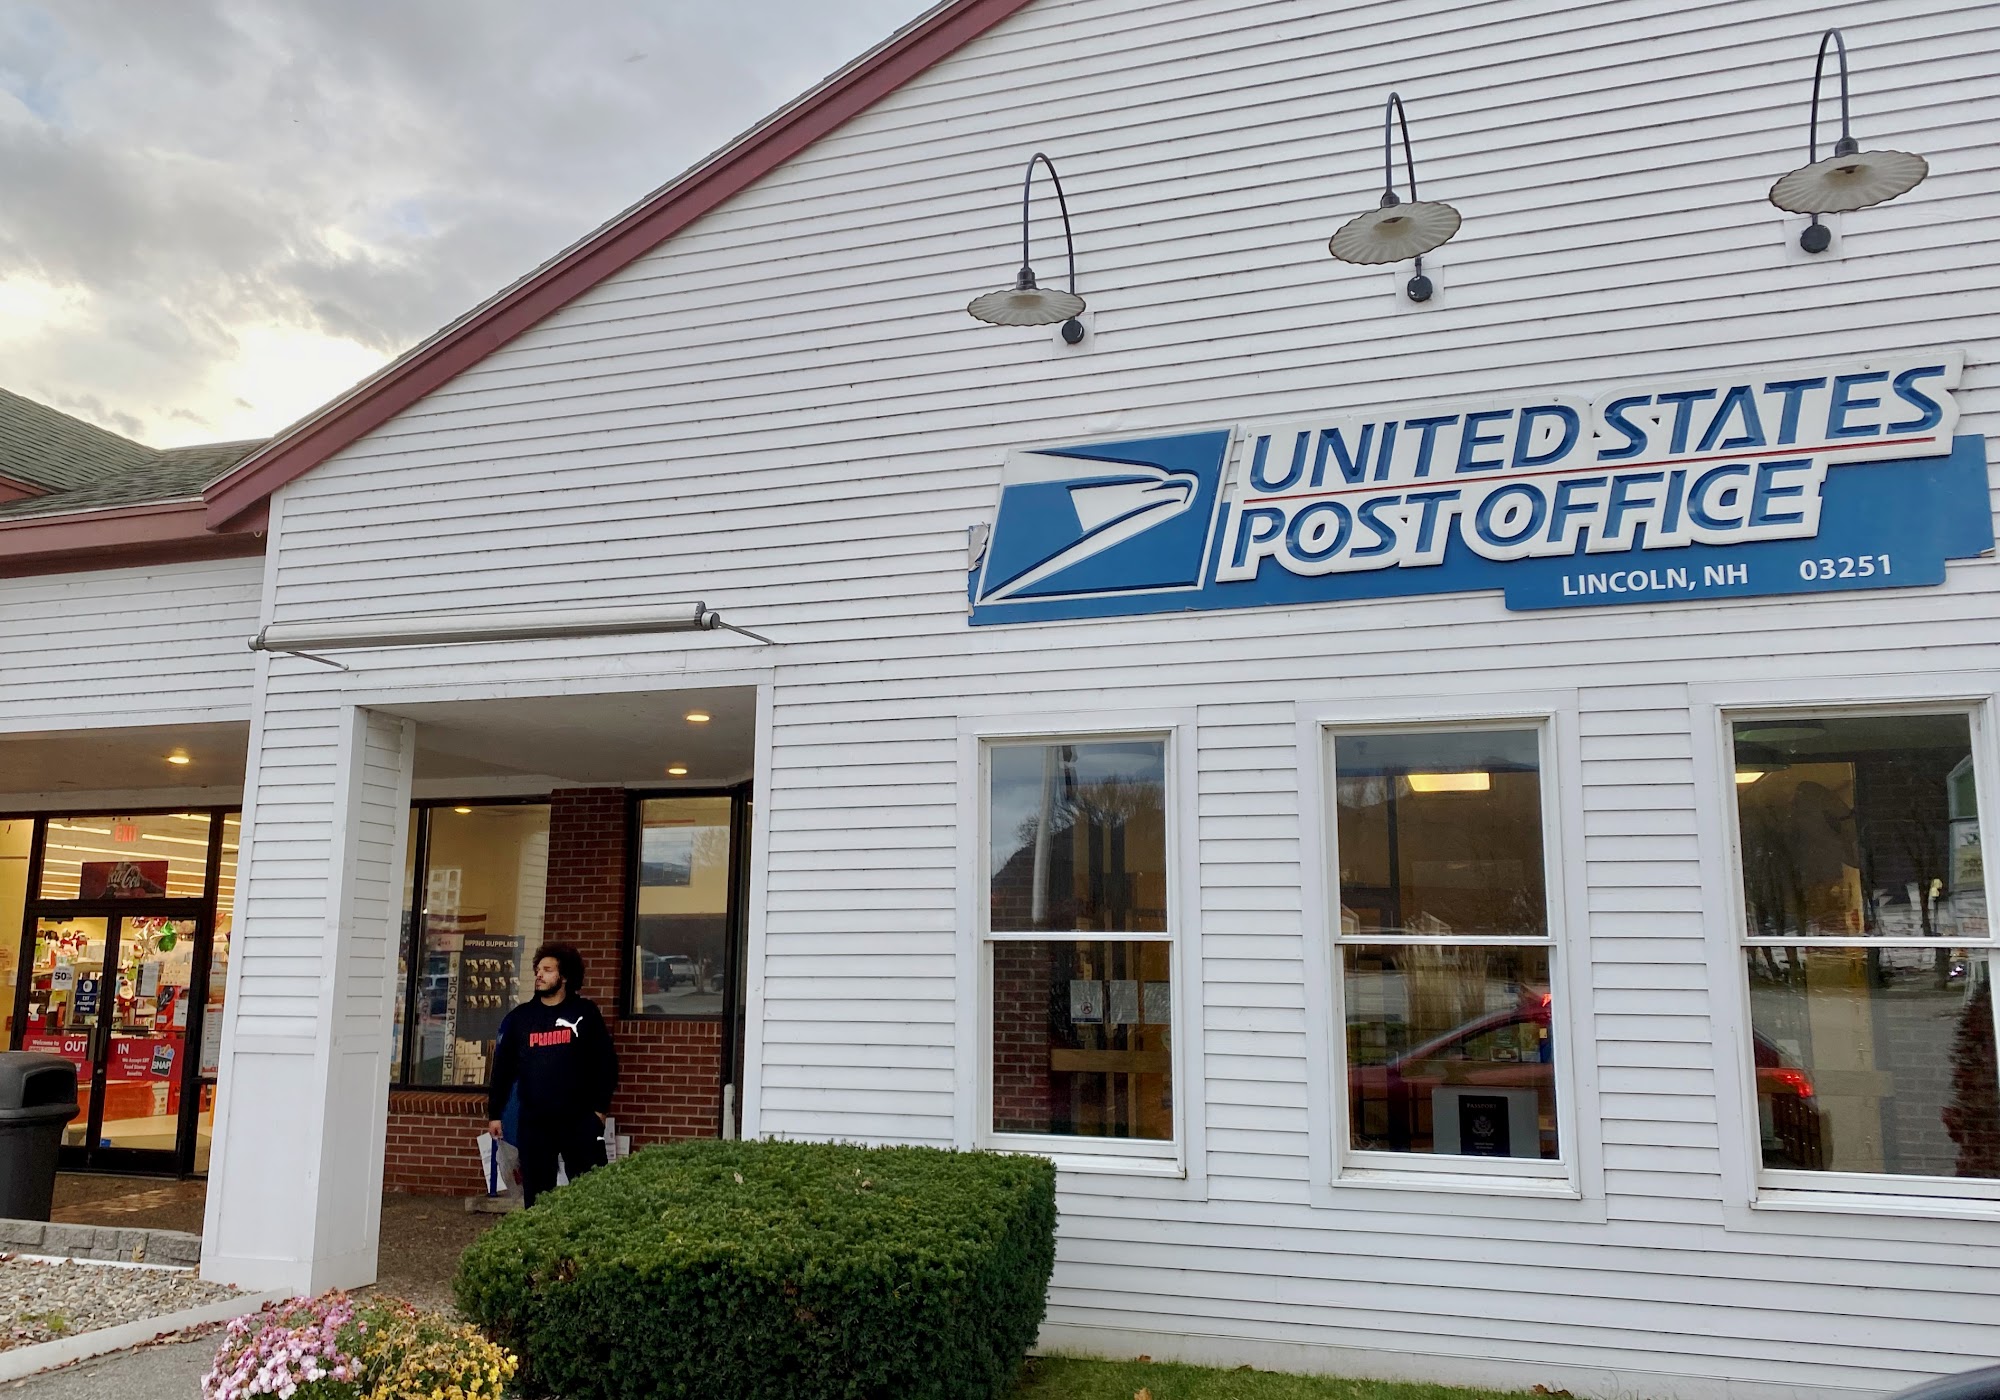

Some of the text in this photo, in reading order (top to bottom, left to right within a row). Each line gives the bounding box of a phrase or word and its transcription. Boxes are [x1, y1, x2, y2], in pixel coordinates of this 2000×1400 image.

[1249, 365, 1947, 493] UNITED STATES
[1231, 458, 1814, 568] POST OFFICE
[1562, 554, 1892, 597] LINCOLN, NH 03251
[114, 825, 138, 842] EXIT
[486, 940, 519, 948] SUPPLIES
[64, 1040, 87, 1052] OUT
[117, 1043, 129, 1054] IN
[151, 1060, 171, 1070] SNAP
